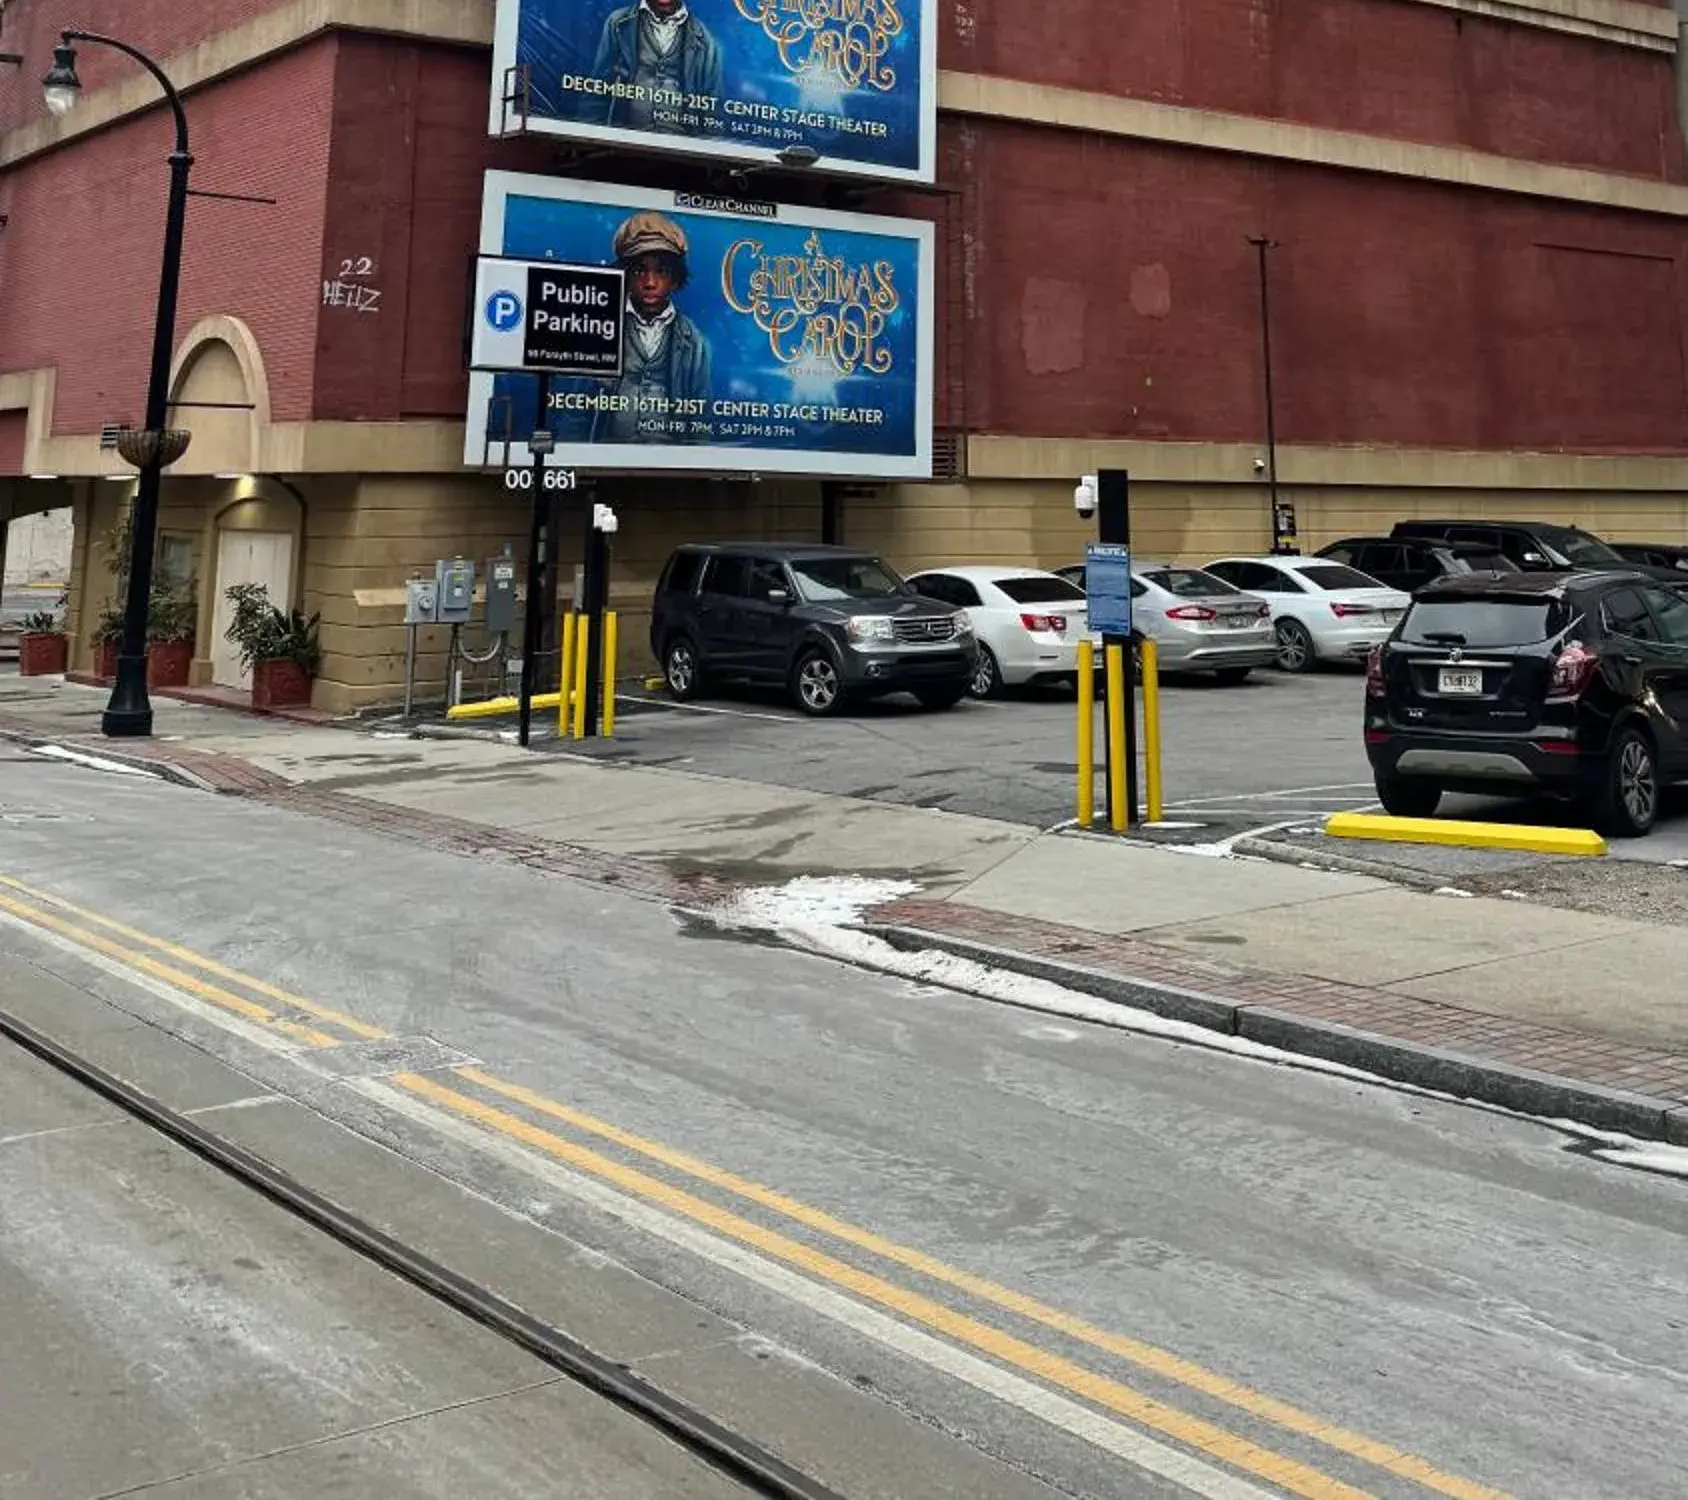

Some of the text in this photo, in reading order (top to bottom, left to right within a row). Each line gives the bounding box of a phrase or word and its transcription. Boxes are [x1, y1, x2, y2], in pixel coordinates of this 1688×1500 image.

[774, 21, 896, 91] CAROL
[562, 74, 888, 138] DECEMBER 16TH-21ST CENTER STAGE THEATER
[731, 121, 751, 133] SAT
[339, 257, 373, 276] 22
[721, 239, 899, 314] CHRISTMAS
[542, 281, 609, 307] Public
[495, 297, 516, 325] P
[533, 310, 616, 341] Parking
[766, 302, 892, 373] CAROL
[633, 394, 706, 415] 16TH-21ST
[713, 400, 768, 418] CENTER
[773, 403, 818, 421] STAGE
[822, 406, 883, 424] THEATER
[719, 422, 739, 435] SAT
[505, 468, 576, 489] 00661
